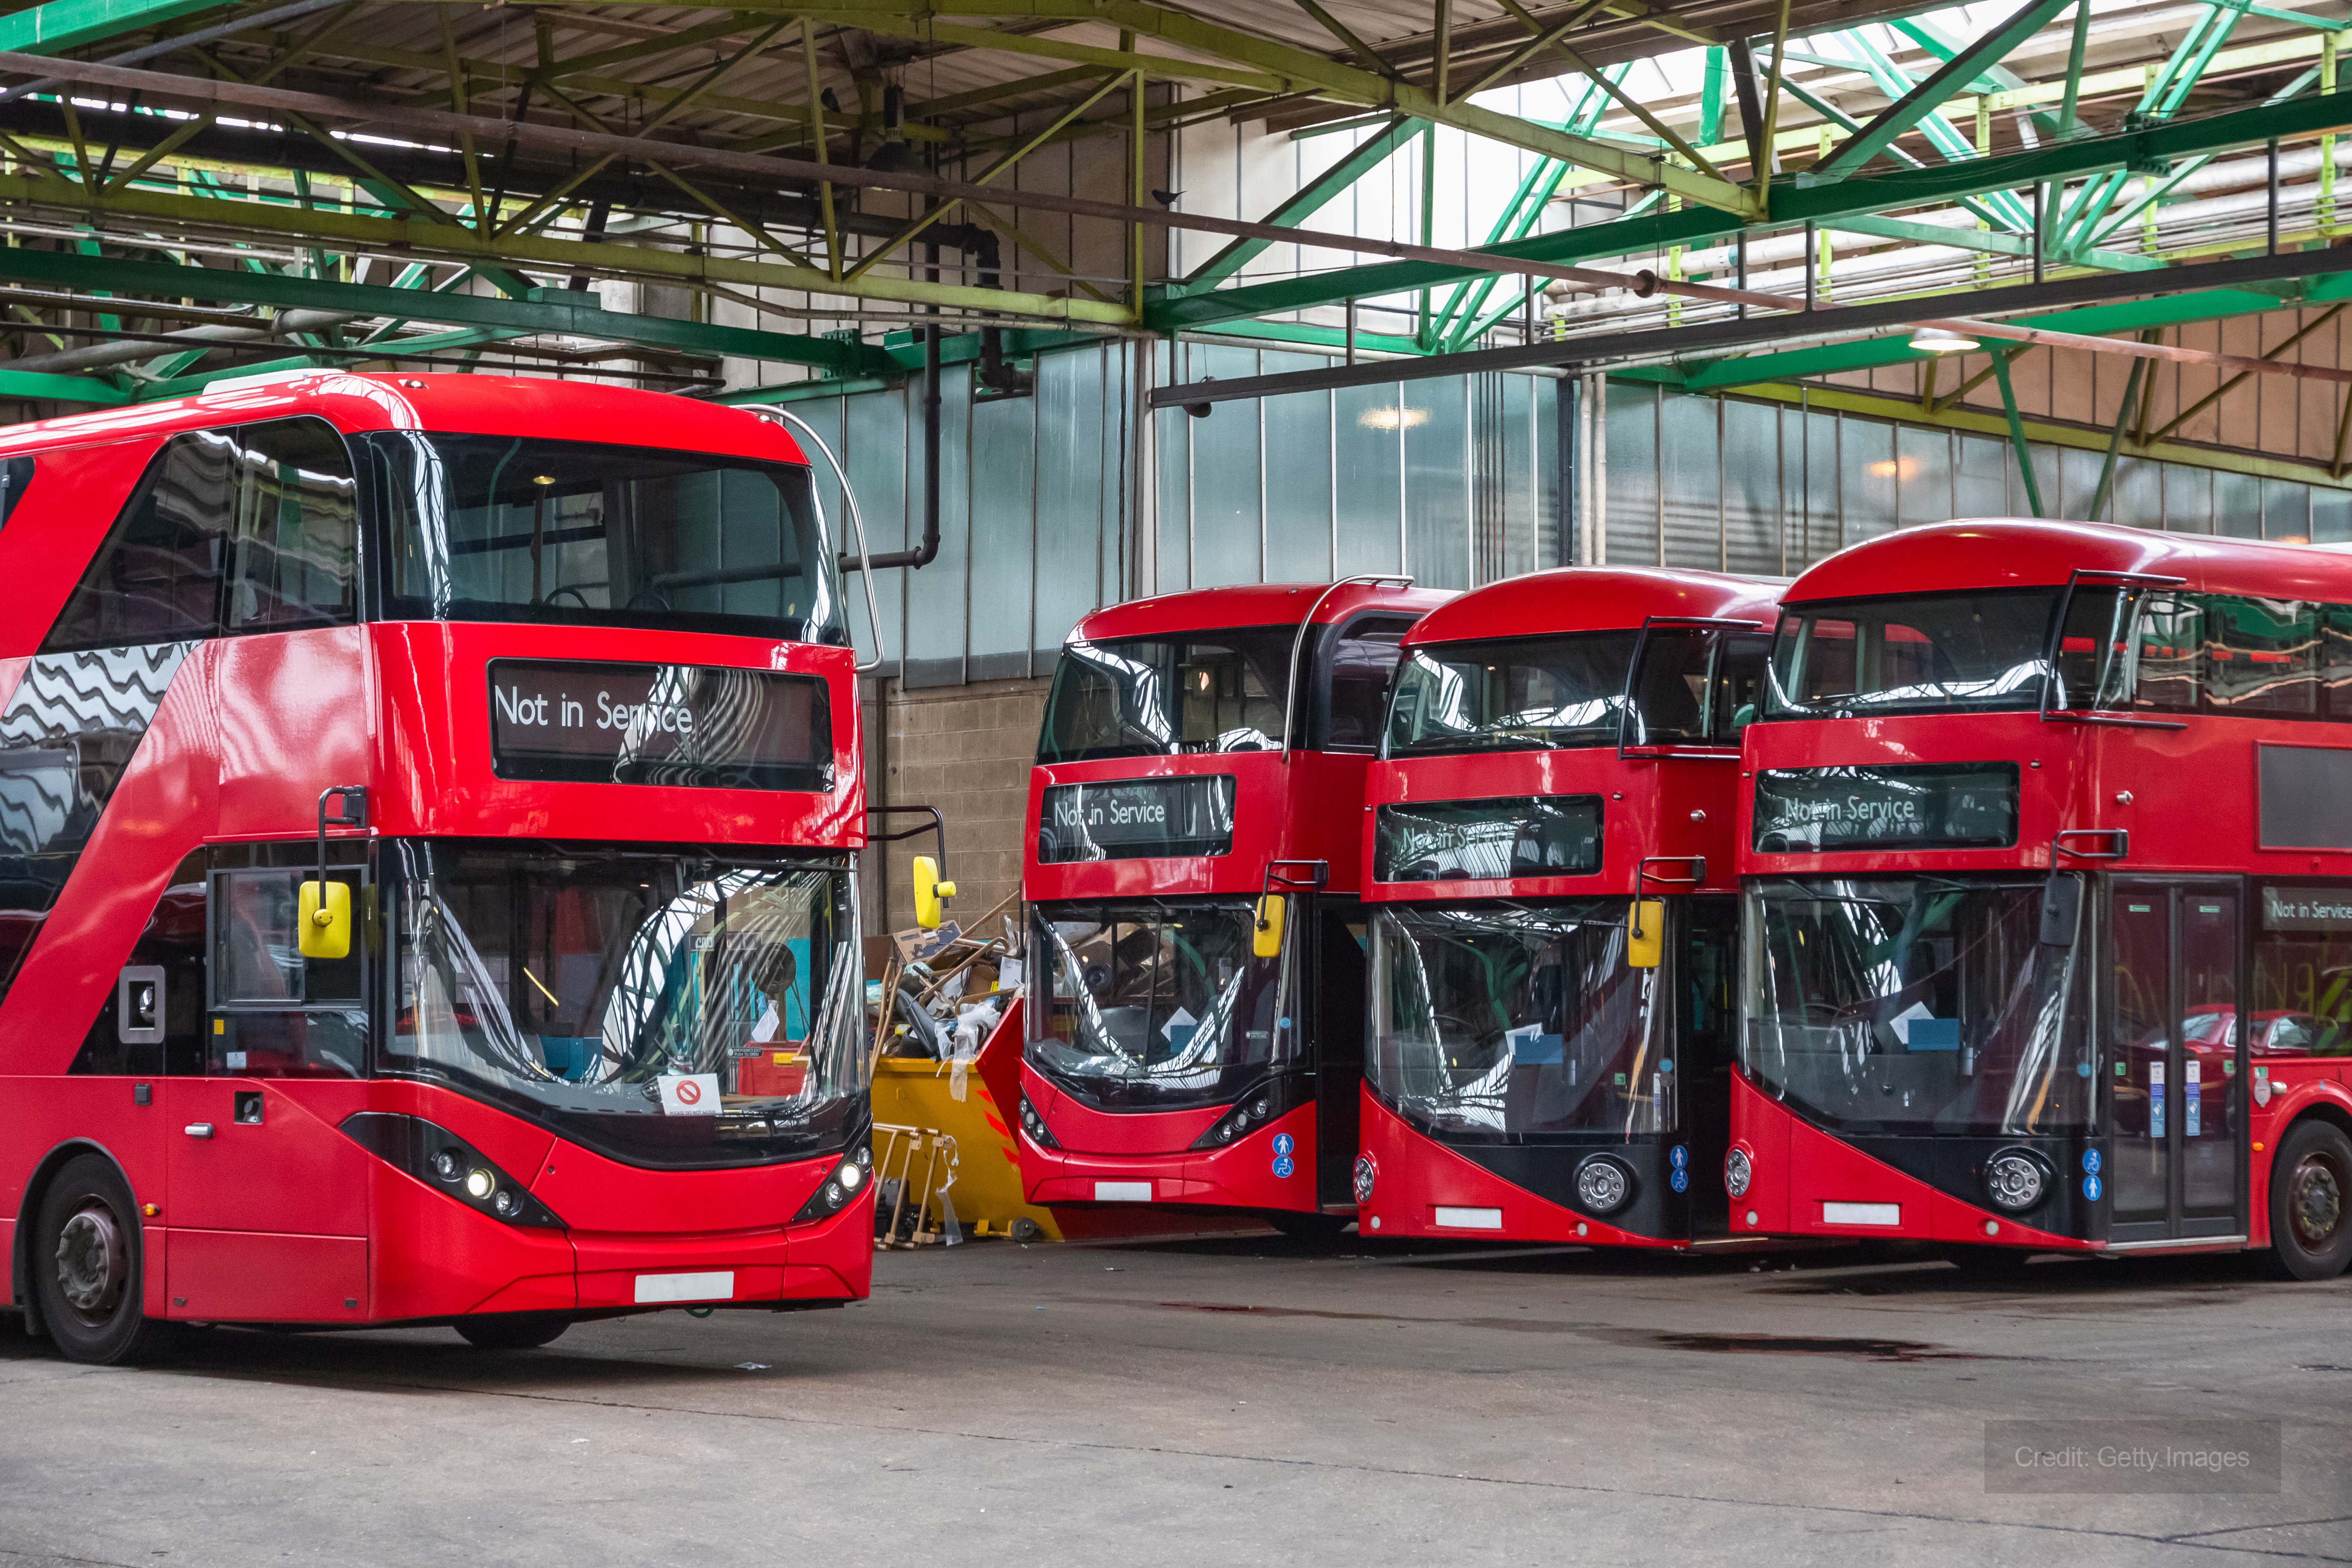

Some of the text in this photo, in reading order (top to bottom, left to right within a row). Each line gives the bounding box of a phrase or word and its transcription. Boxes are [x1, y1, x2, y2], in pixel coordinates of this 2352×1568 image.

[495, 685, 692, 733] Not in Service
[1055, 799, 1165, 827] Not in Service
[1785, 795, 1915, 821] Not in Service
[2272, 900, 2352, 919] Not in Service
